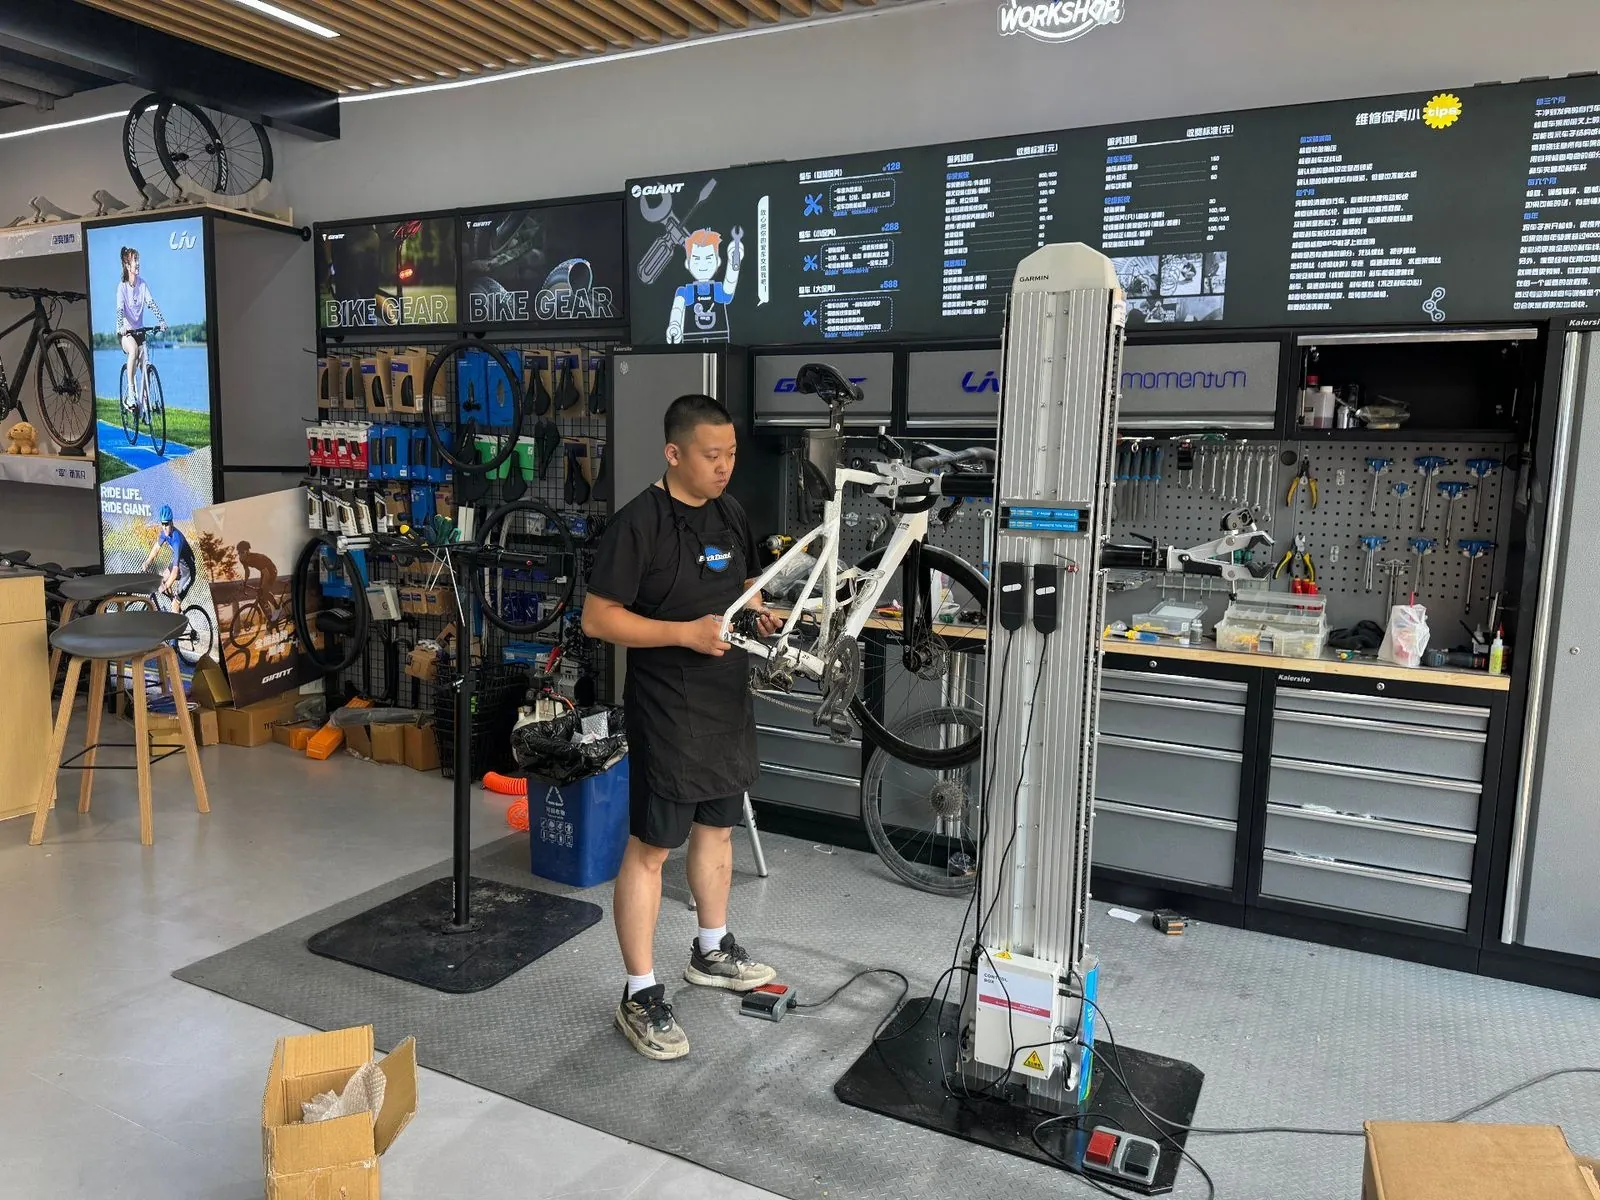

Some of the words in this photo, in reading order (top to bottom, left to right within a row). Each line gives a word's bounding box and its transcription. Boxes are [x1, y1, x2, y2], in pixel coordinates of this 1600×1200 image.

[1001, 0, 1119, 31] WORKSHOP
[1356, 108, 1420, 126] 维修保养小
[1428, 107, 1458, 118] tips
[642, 183, 684, 196] GIANT
[169, 231, 197, 250] Liv
[326, 298, 377, 328] BIKE
[382, 295, 449, 325] GEAR
[469, 290, 529, 323] BIKE
[535, 287, 614, 321] GEAR
[1121, 370, 1246, 389] momentum
[101, 486, 121, 499] RIDE
[122, 487, 142, 500] LIFE.
[101, 501, 122, 514] RIDE
[123, 502, 151, 516] GIANT.
[261, 667, 294, 684] GIANT
[1278, 674, 1310, 683] Kaiersite
